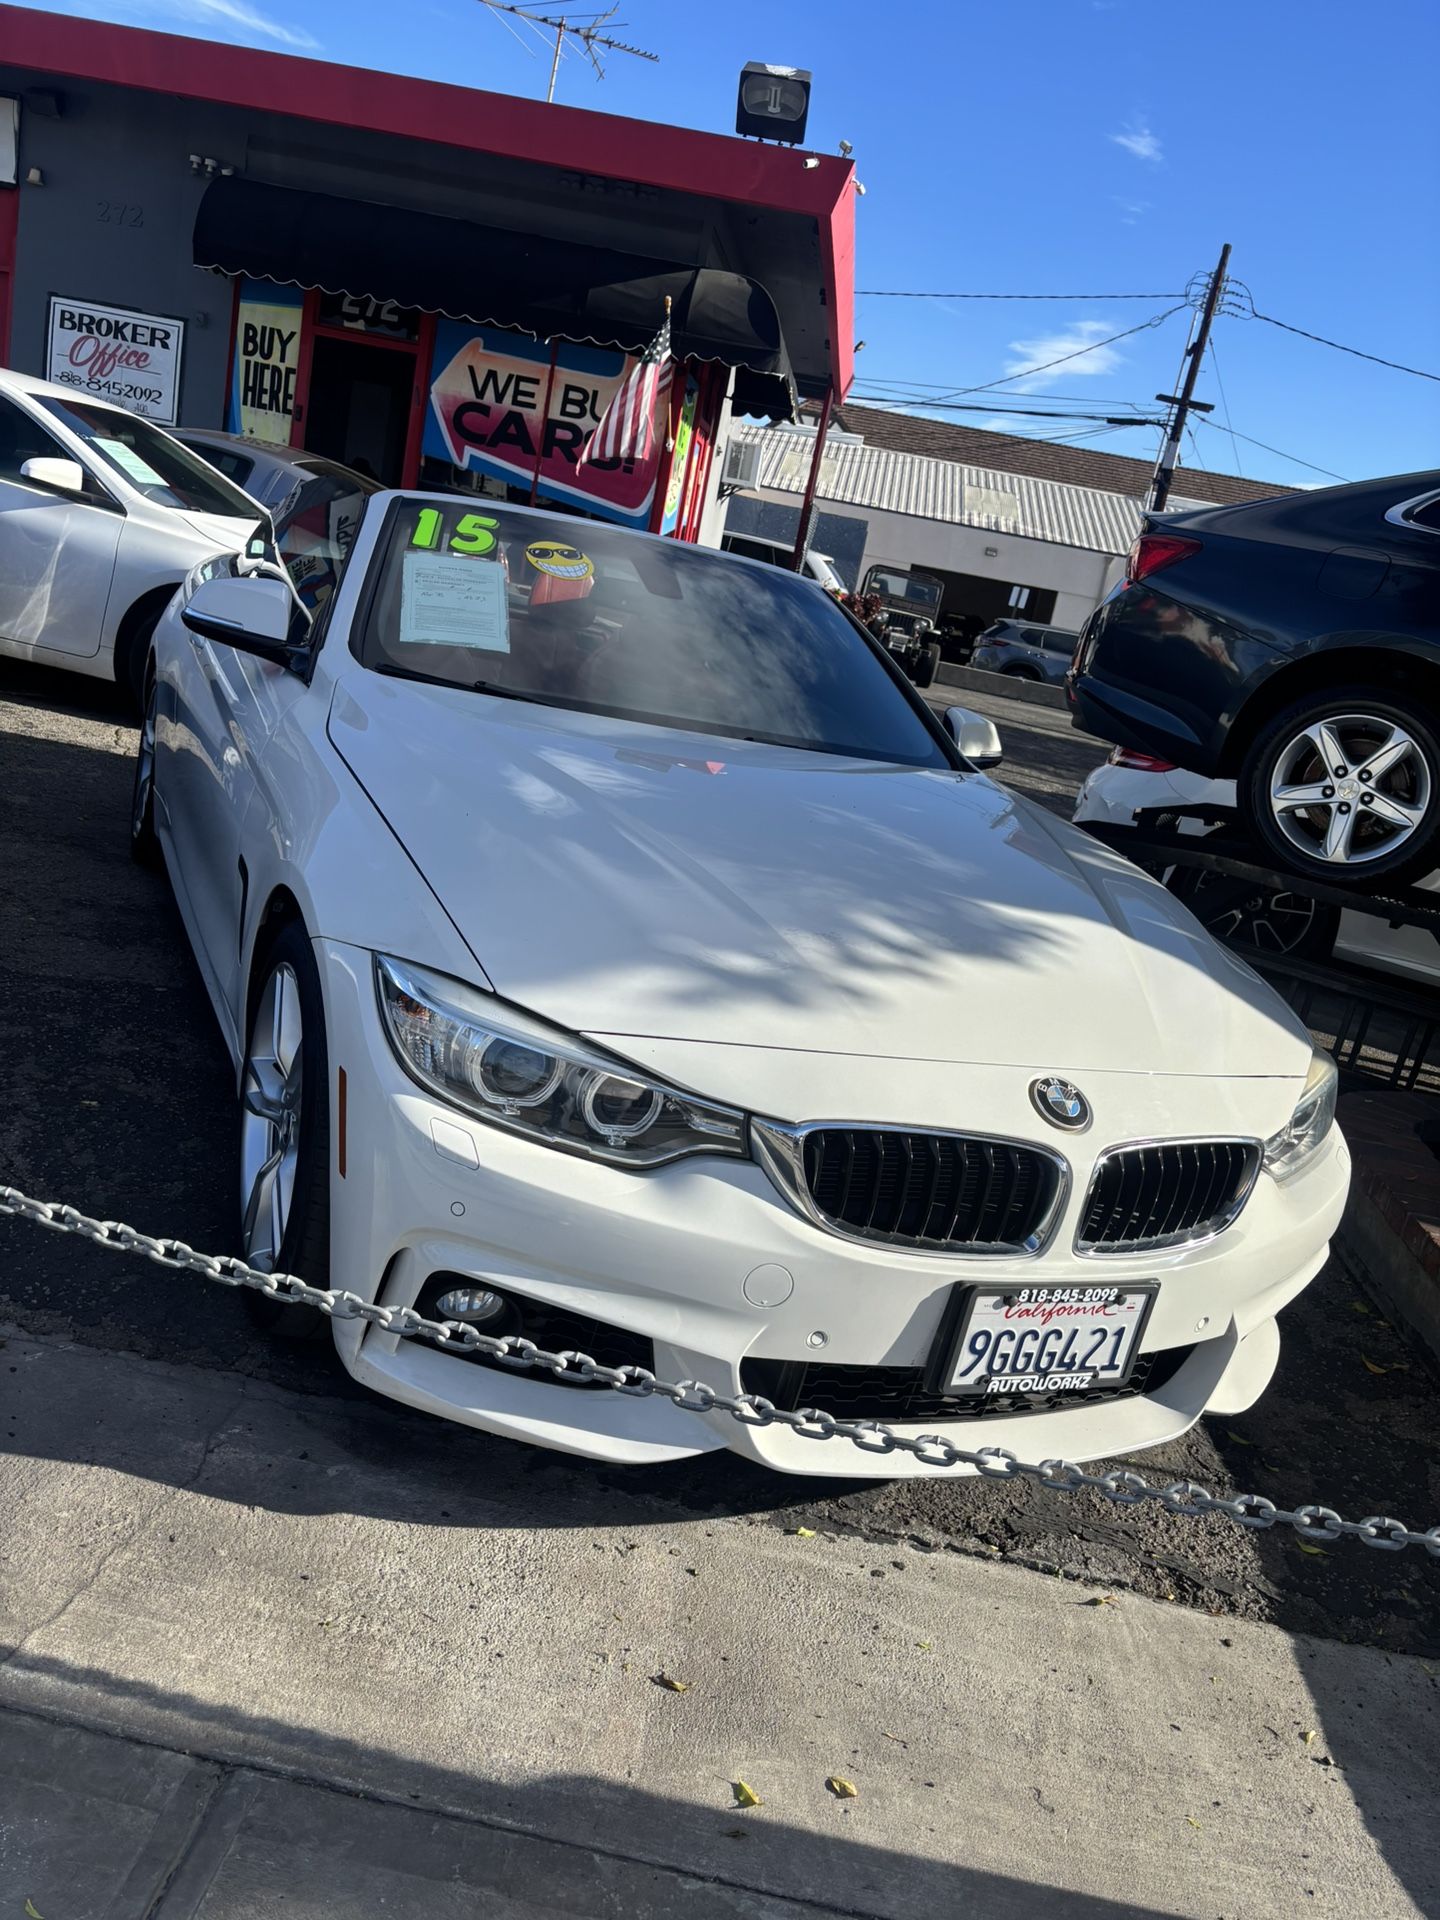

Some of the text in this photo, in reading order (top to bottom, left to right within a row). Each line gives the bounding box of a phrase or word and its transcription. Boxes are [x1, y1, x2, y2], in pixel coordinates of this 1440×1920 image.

[96, 200, 144, 228] 272
[59, 309, 171, 350] BROKER
[242, 322, 297, 364] BUY
[69, 335, 151, 377] Office
[242, 359, 297, 416] HERE
[467, 365, 601, 423] WE BU
[412, 508, 500, 554] 15
[1038, 1078, 1078, 1093] BMW
[1004, 1299, 1118, 1326] California
[1018, 1288, 1119, 1303] 818-845-2092
[959, 1326, 1127, 1378] 9GGG421
[986, 1373, 1093, 1393] AUTOWORKZ
